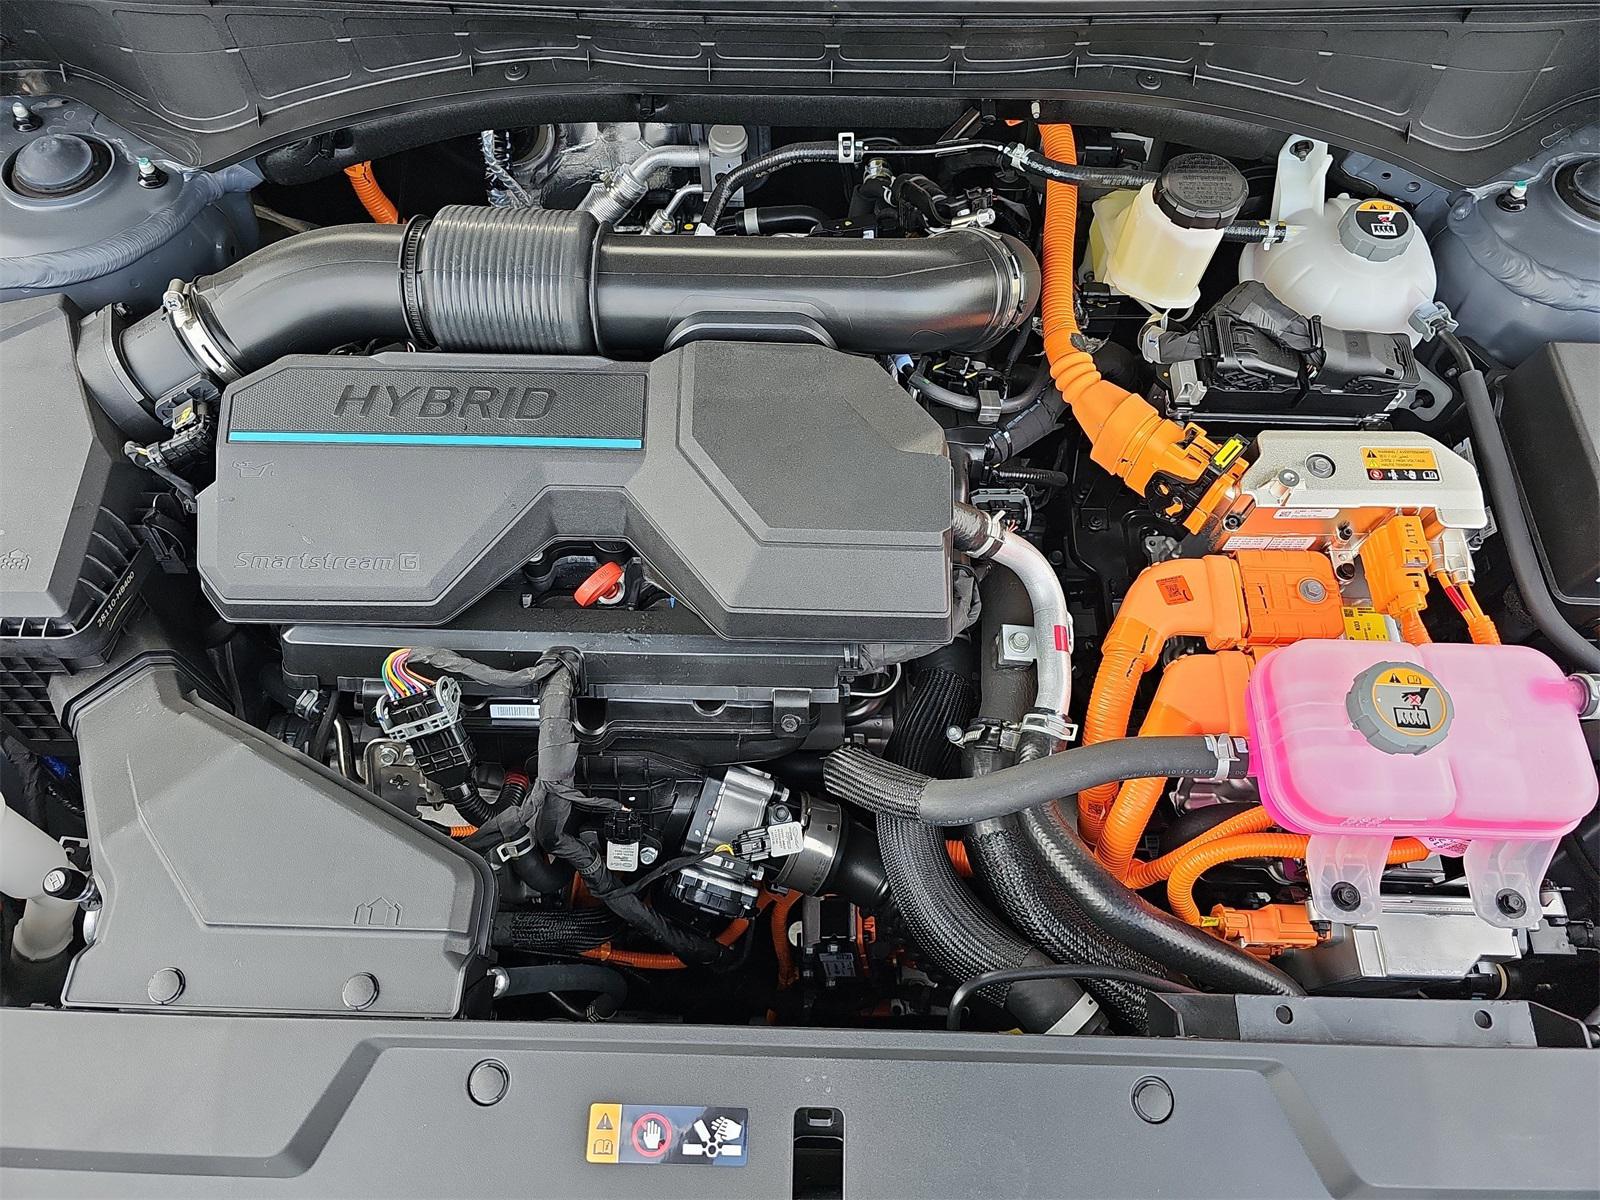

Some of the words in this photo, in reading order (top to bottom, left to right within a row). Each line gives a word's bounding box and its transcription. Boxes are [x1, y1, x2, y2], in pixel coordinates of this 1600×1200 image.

[332, 384, 558, 420] HYBRID
[234, 551, 394, 571] Smartstream
[401, 552, 420, 571] G
